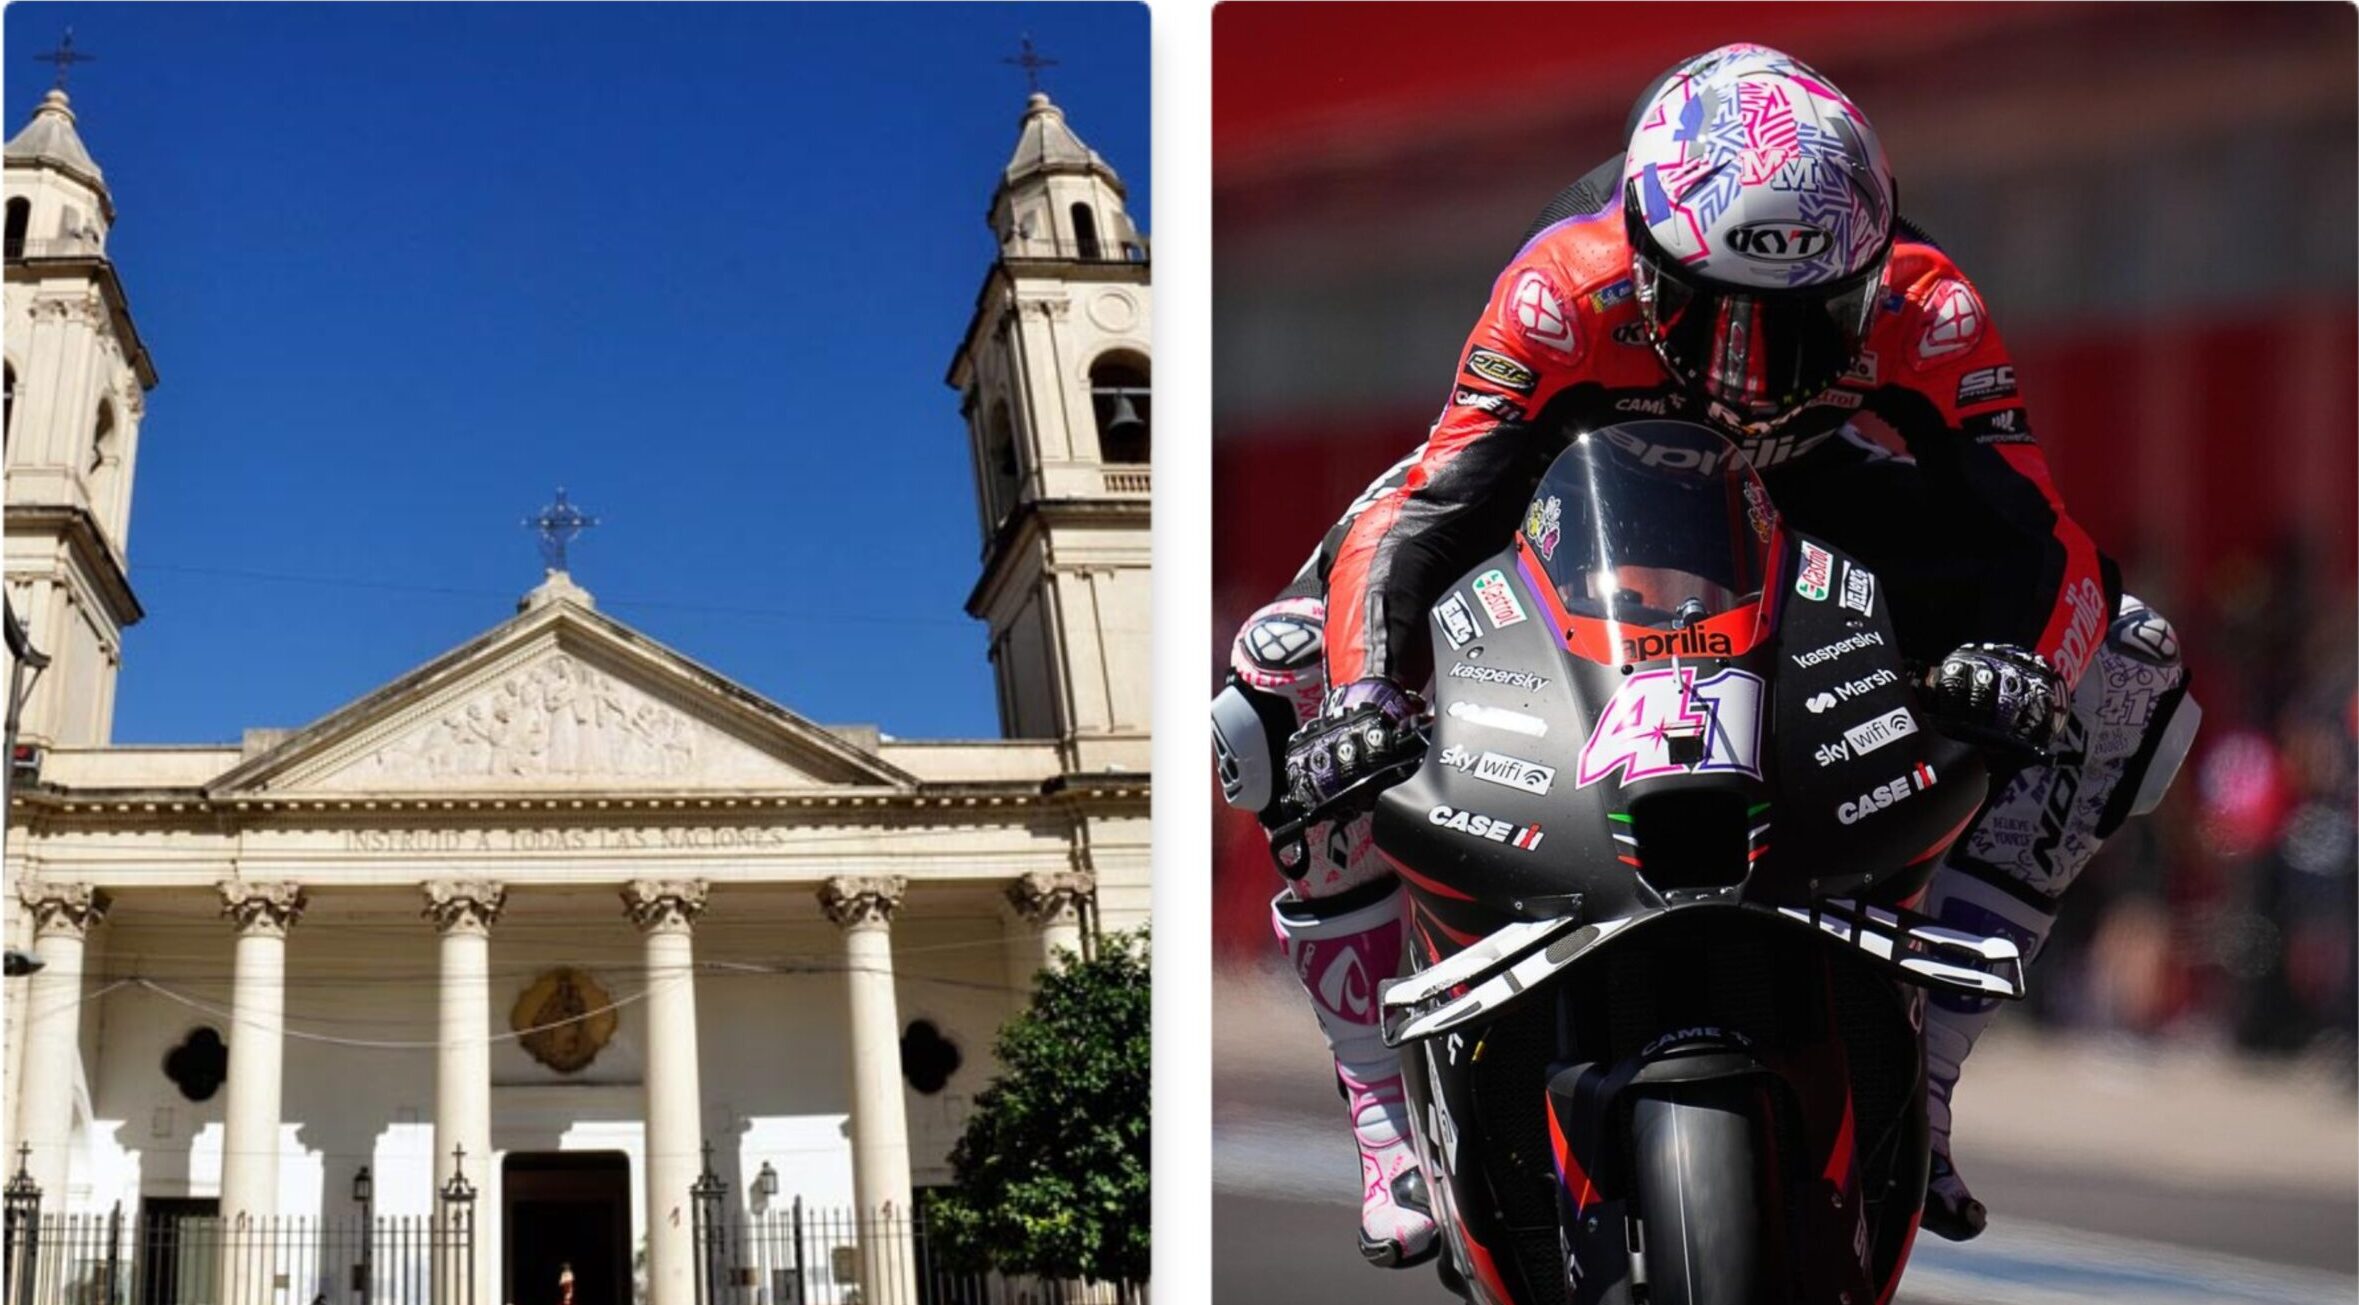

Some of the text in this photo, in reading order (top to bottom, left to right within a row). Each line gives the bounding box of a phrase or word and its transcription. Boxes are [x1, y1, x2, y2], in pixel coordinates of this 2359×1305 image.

[1733, 228, 1822, 255] KYT
[1801, 544, 1829, 588] Castrol
[1621, 624, 1733, 662] aprilia
[1792, 631, 1885, 669] kaspersky
[1448, 661, 1550, 693] kaspersky
[1834, 668, 1898, 702] Marsh
[1576, 666, 1766, 790] 41
[1815, 720, 1892, 767] sky wifi
[1439, 744, 1524, 782] sky wifi
[1837, 776, 1912, 826] CASE
[345, 827, 787, 852] INSTRUID A TODAS LAS NACIONES
[1428, 804, 1514, 843] CASE
